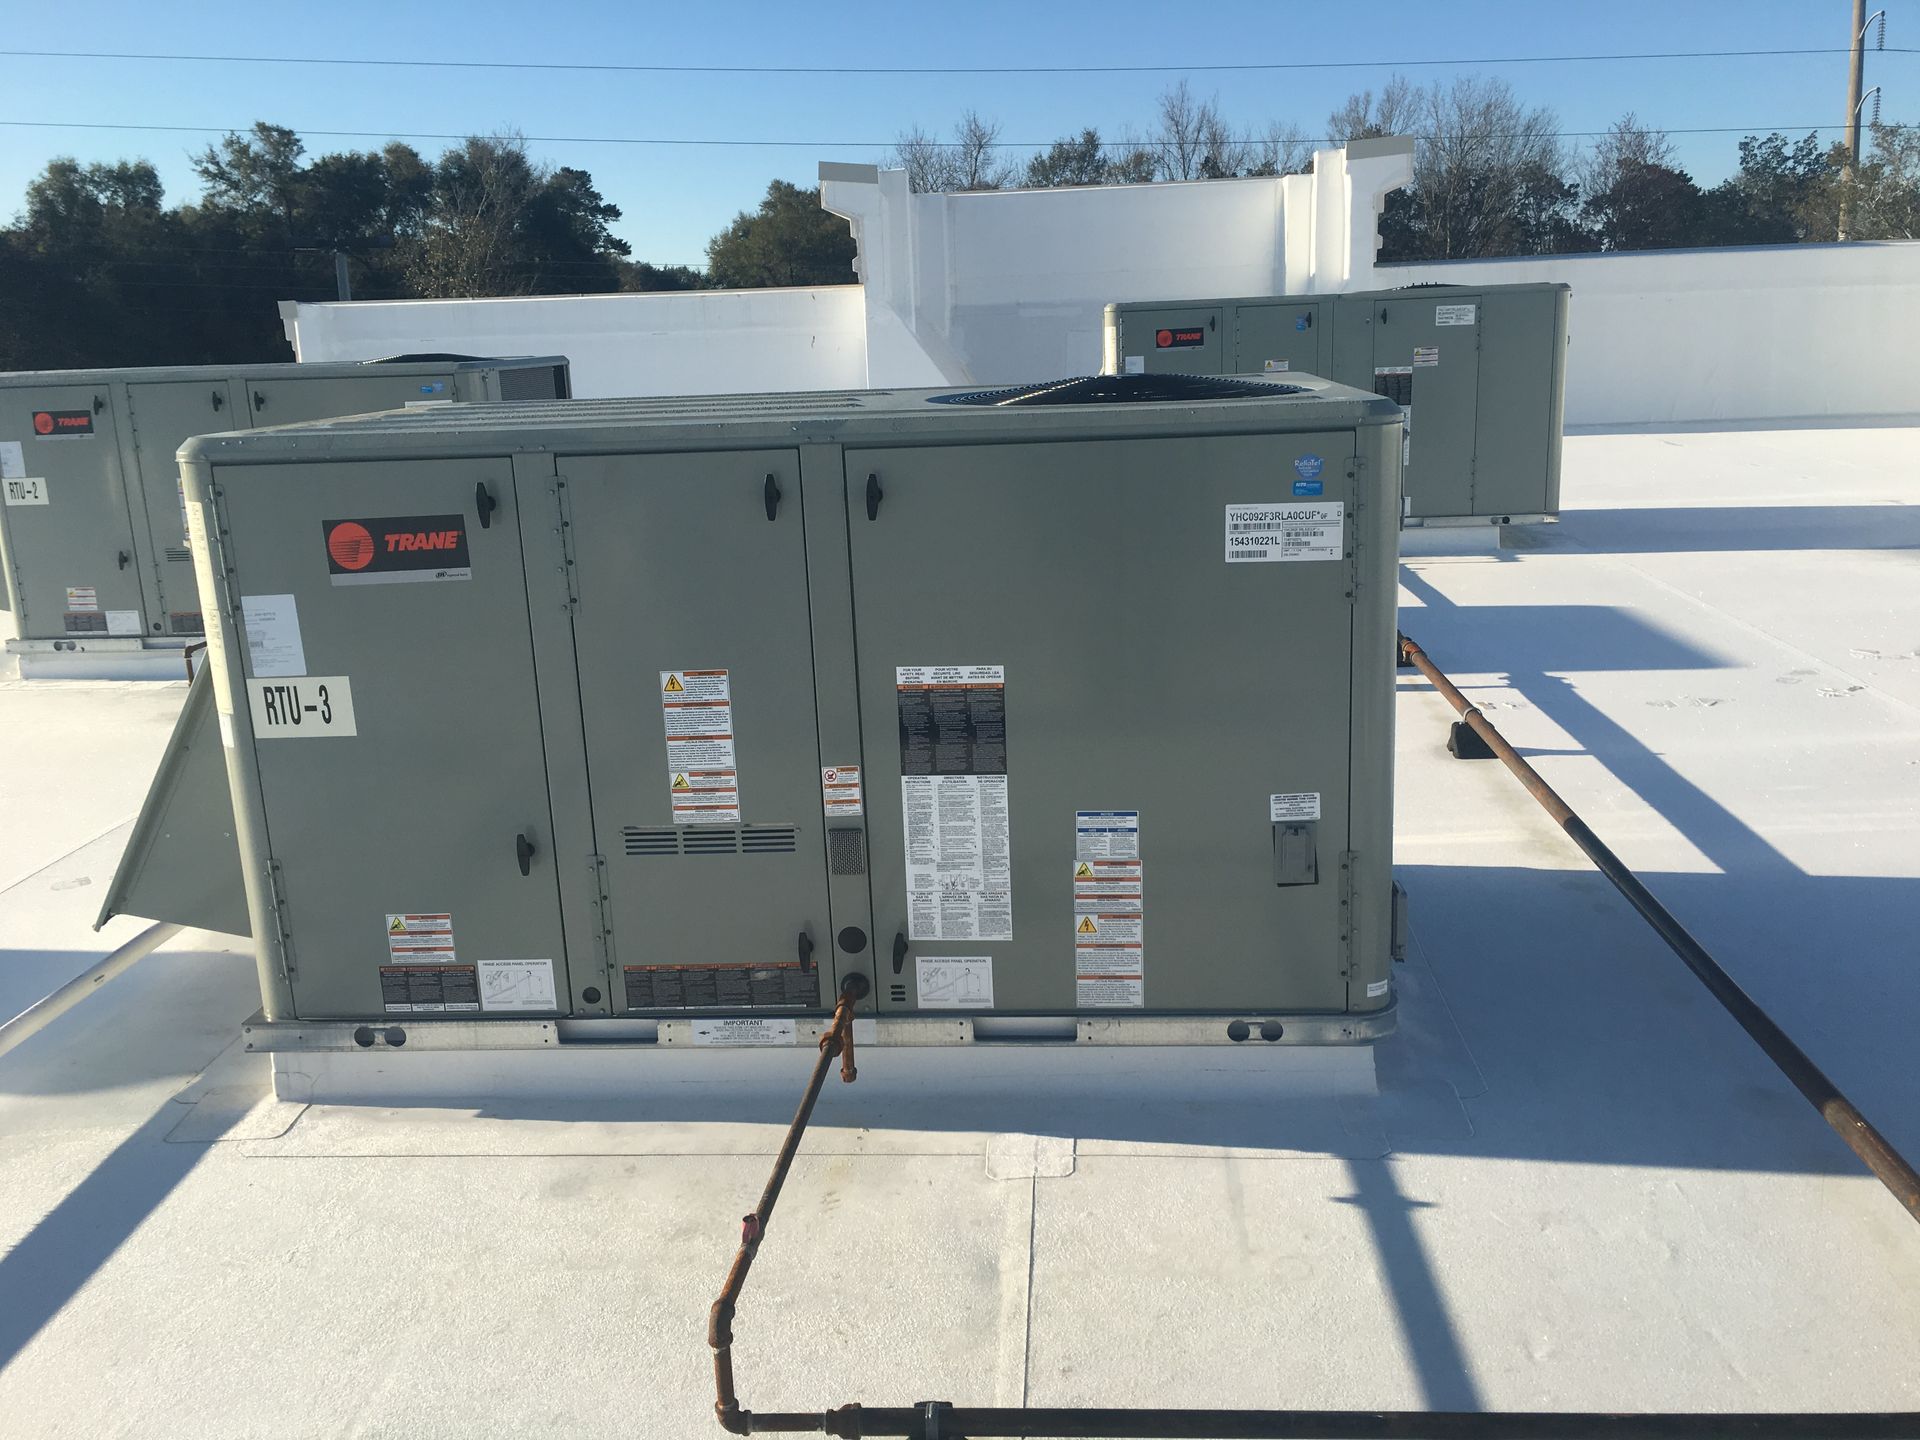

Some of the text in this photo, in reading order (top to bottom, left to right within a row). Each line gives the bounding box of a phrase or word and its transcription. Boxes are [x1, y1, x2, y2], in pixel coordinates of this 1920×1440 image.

[1175, 332, 1202, 341] TRANE
[58, 416, 89, 427] TRANE
[8, 481, 39, 500] RTU-2
[384, 531, 458, 552] TRANE
[1229, 536, 1280, 546] 154310221L
[262, 684, 332, 725] RTU-3
